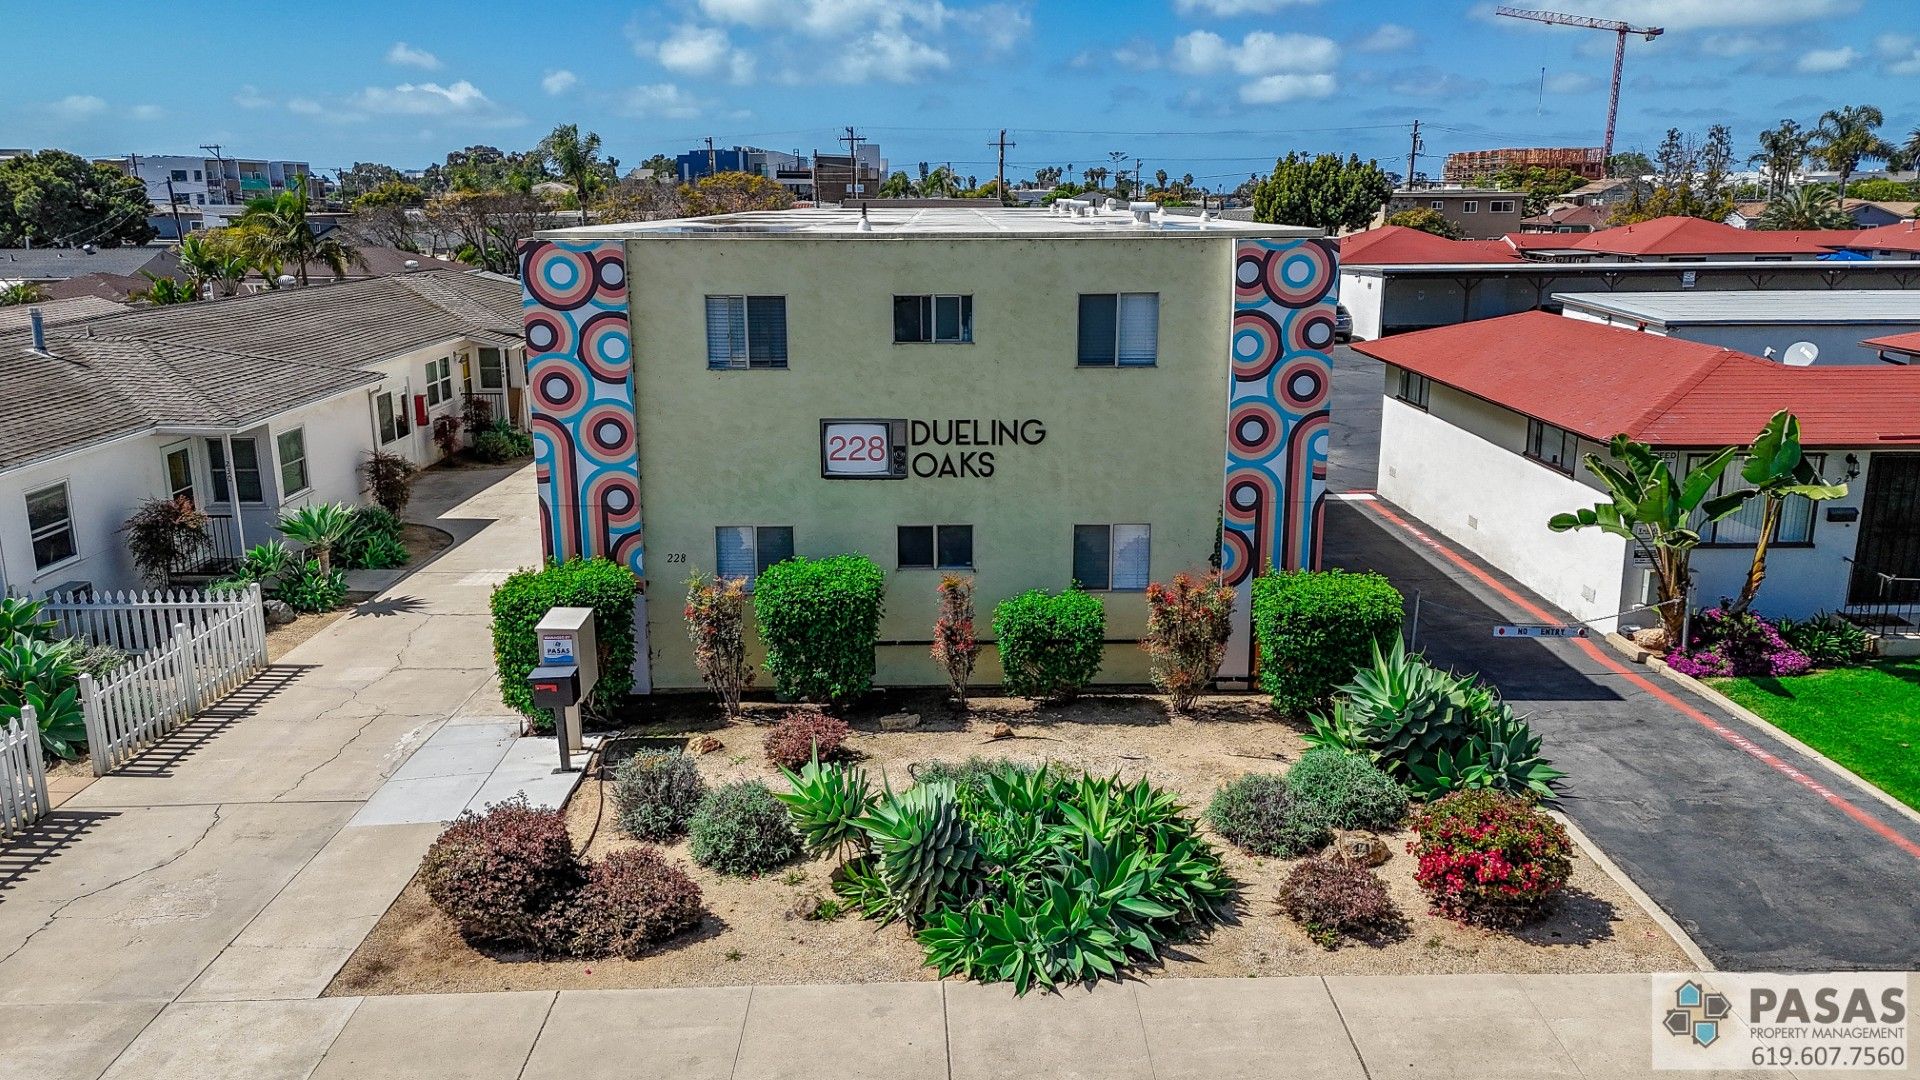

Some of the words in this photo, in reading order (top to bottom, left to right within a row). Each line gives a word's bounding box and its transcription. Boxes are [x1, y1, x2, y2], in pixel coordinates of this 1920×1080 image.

[911, 419, 1046, 446] DUELING
[828, 435, 886, 462] 228
[912, 451, 995, 478] OAKS
[667, 553, 687, 563] 228
[1540, 628, 1565, 636] ENTRY
